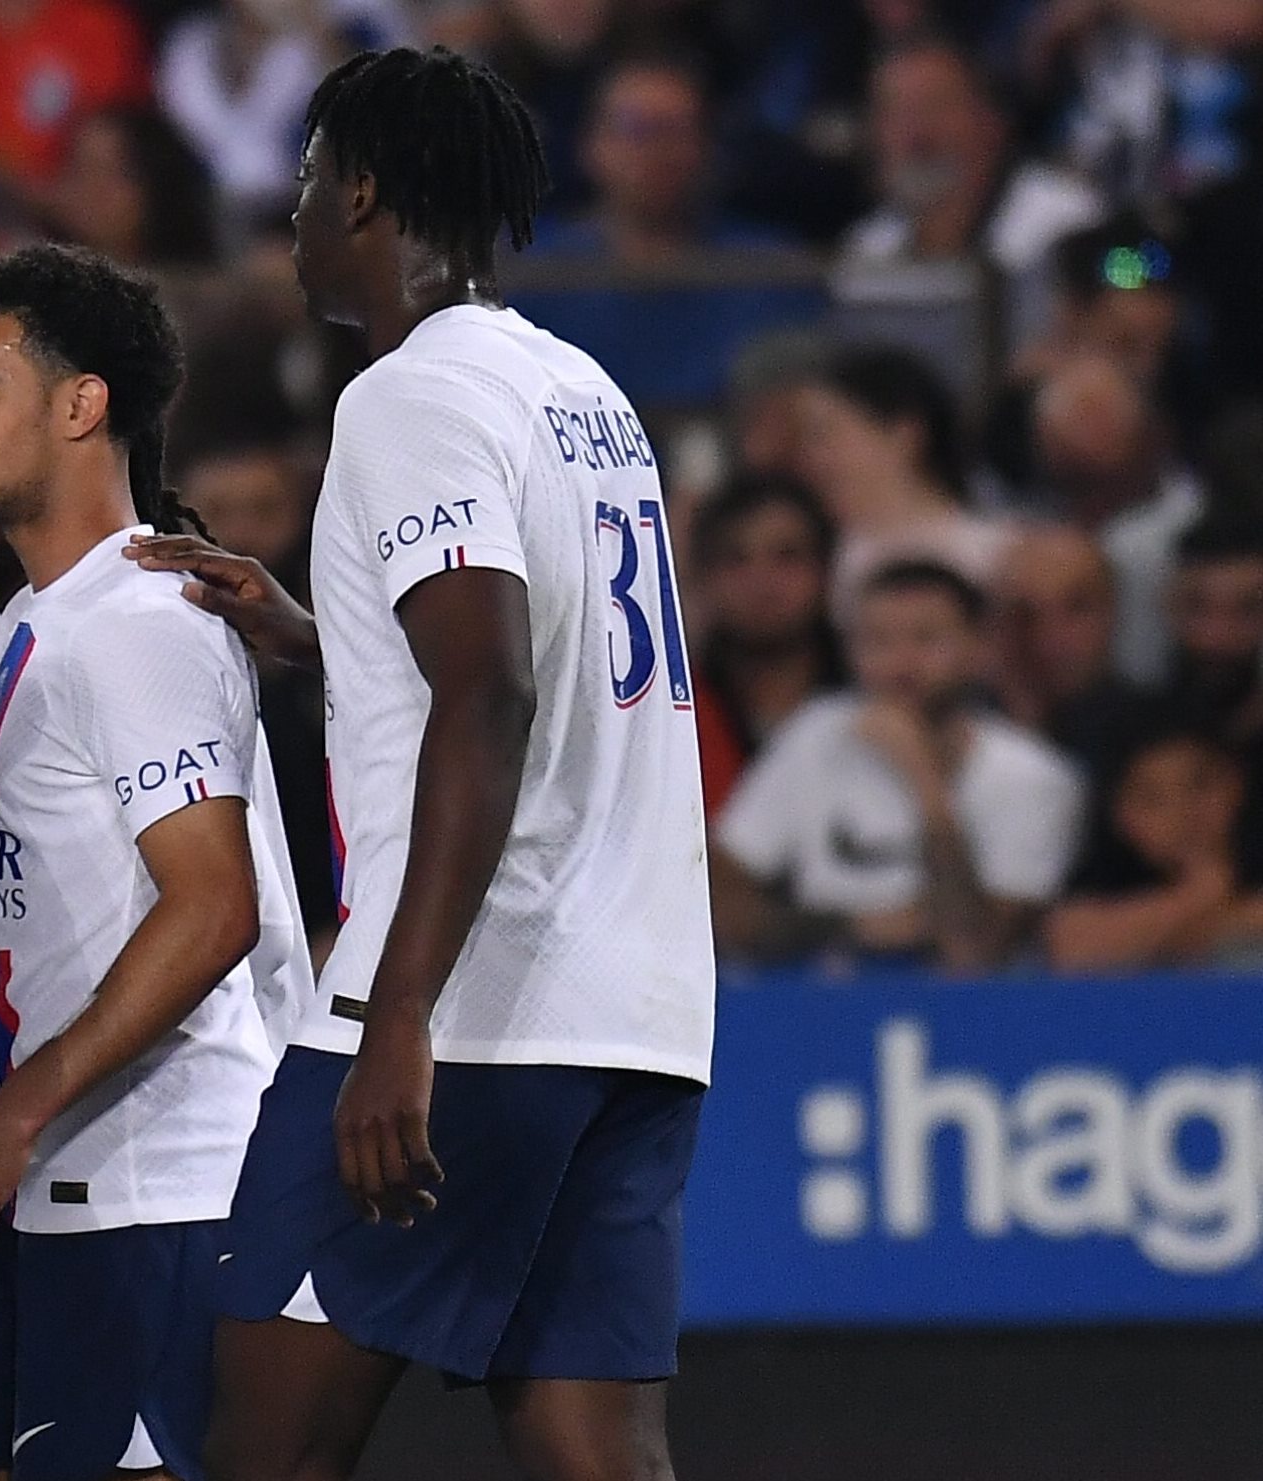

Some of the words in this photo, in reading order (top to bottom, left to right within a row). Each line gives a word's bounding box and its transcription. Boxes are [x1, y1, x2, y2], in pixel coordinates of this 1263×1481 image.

[378, 498, 477, 562] GOAT
[595, 499, 692, 710] 31
[115, 740, 221, 806] GOAT
